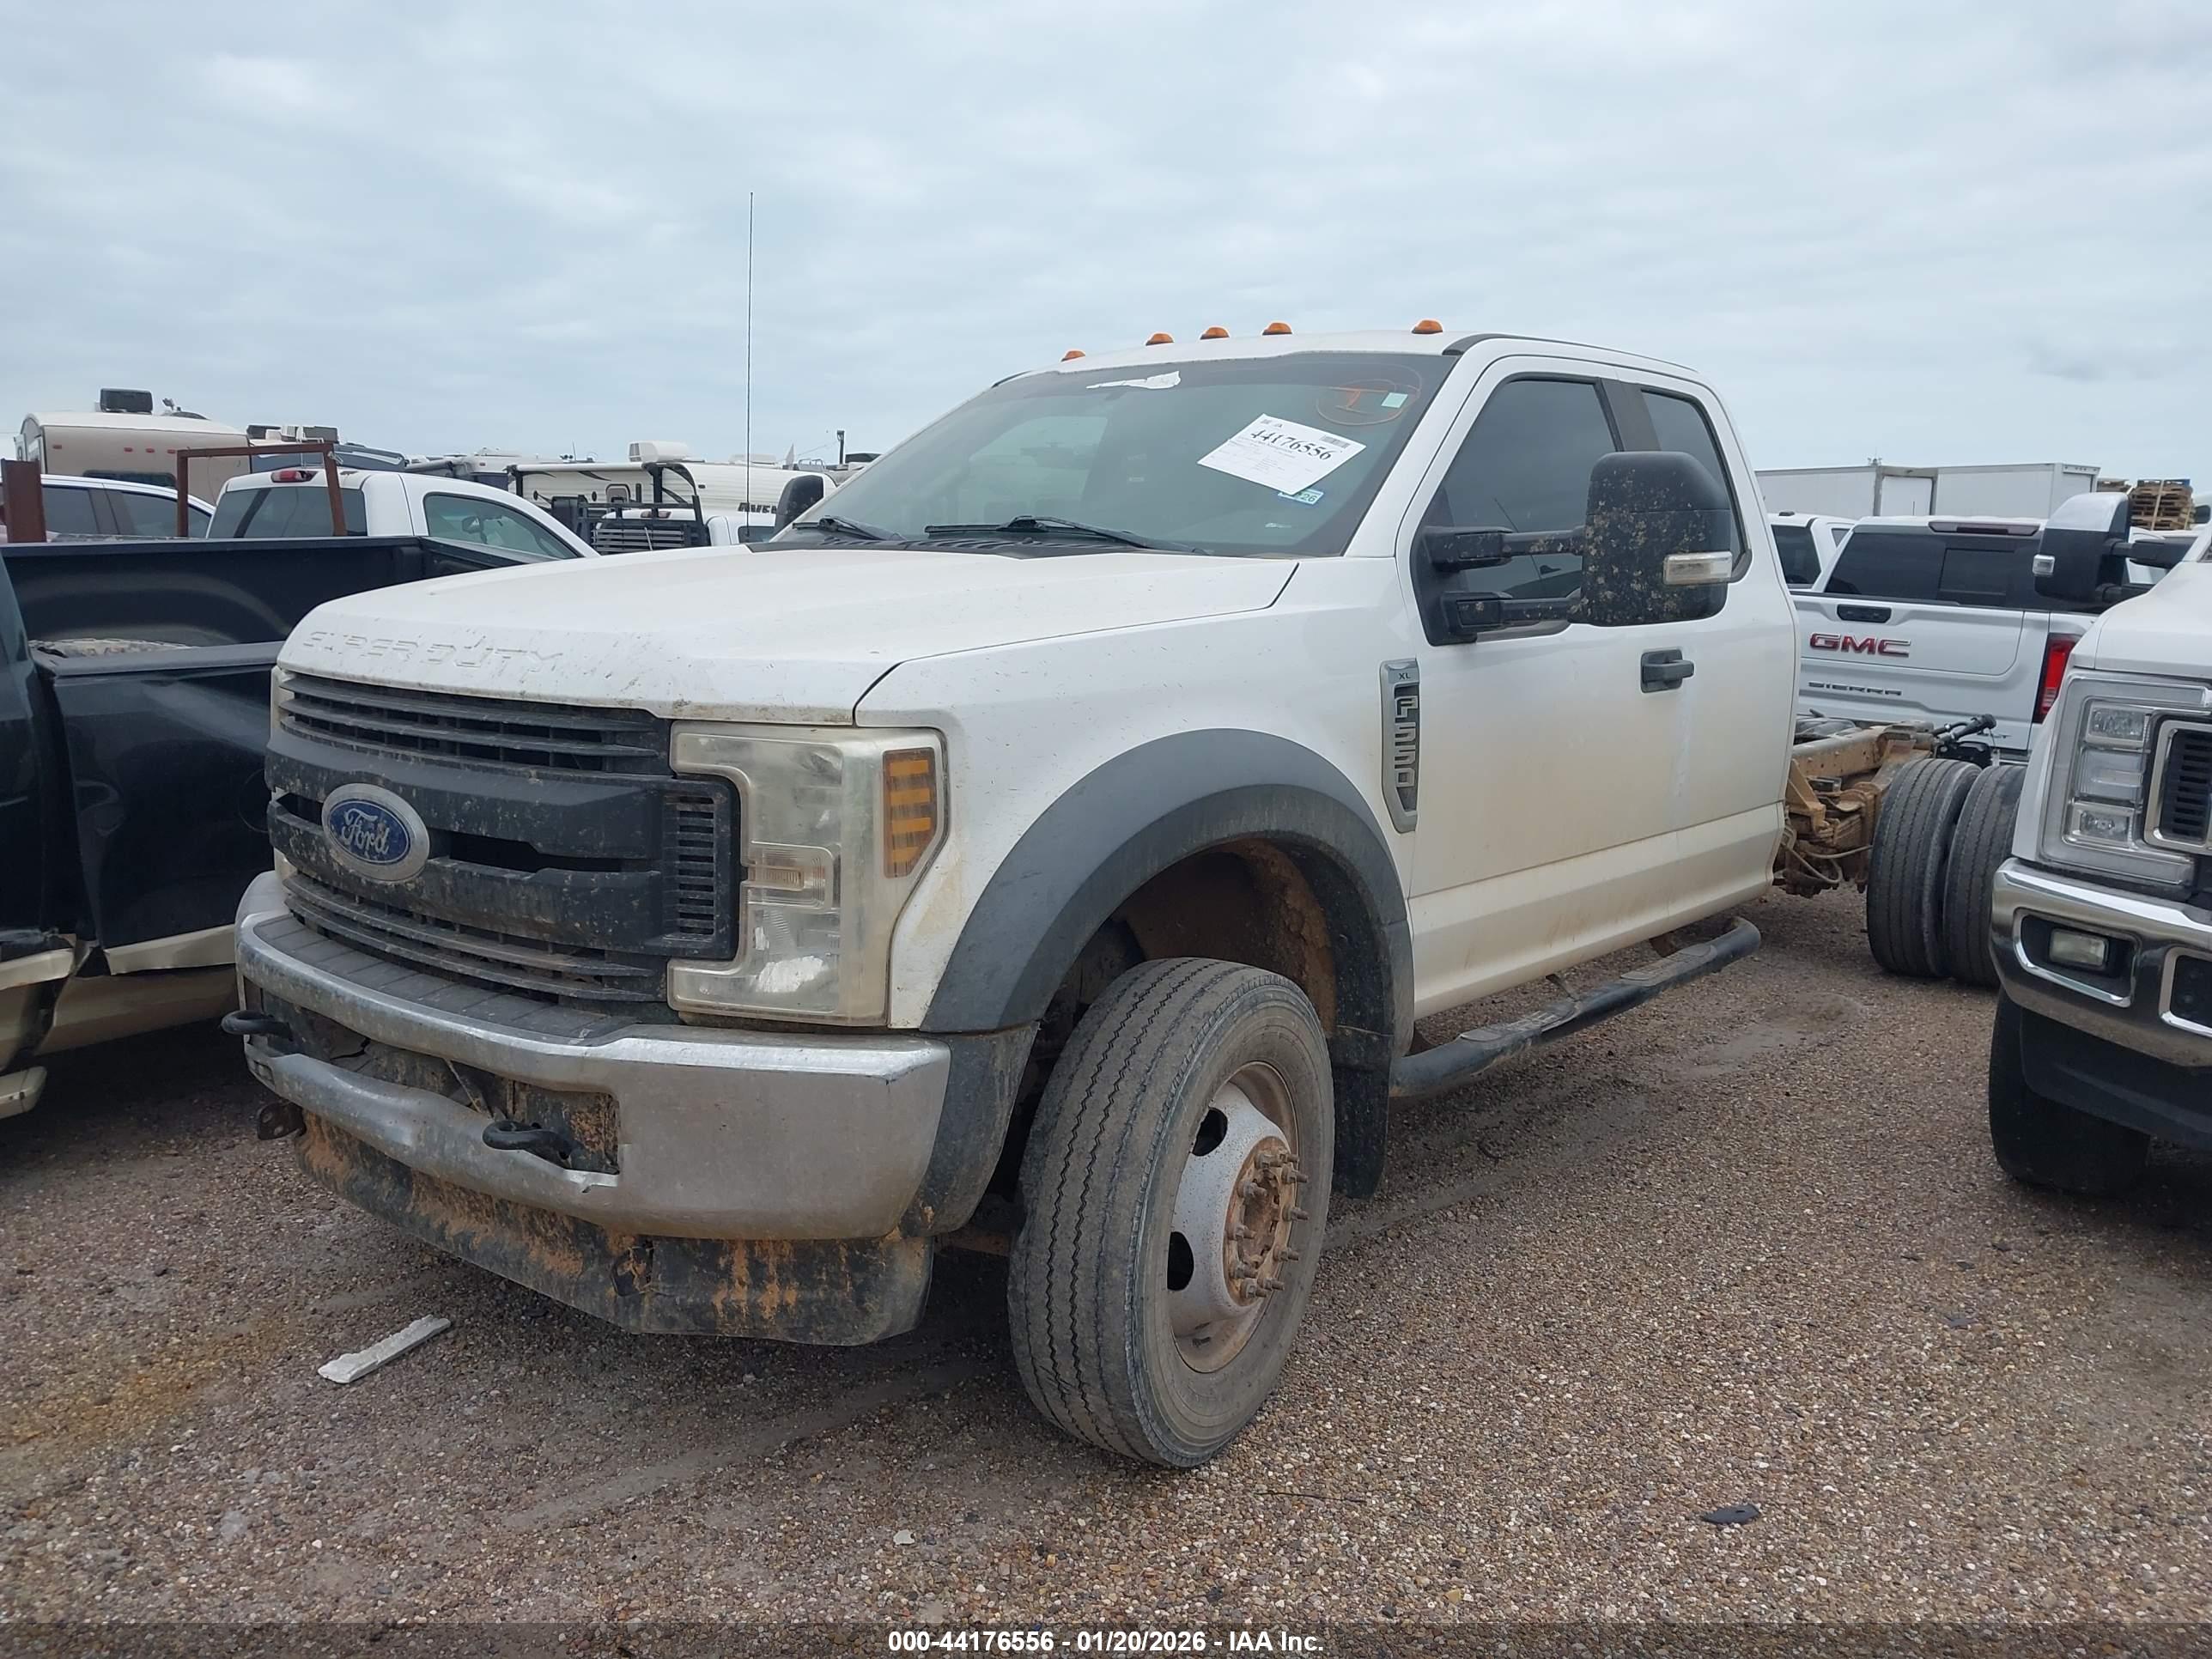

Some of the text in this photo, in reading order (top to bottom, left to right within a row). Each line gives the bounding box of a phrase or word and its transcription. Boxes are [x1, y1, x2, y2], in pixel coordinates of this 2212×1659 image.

[1250, 428, 1334, 461] 44176556
[1809, 633, 1911, 659] GMC
[1398, 672, 1412, 681] XL
[1808, 681, 1902, 696] SIERRA
[340, 808, 391, 855] Ford
